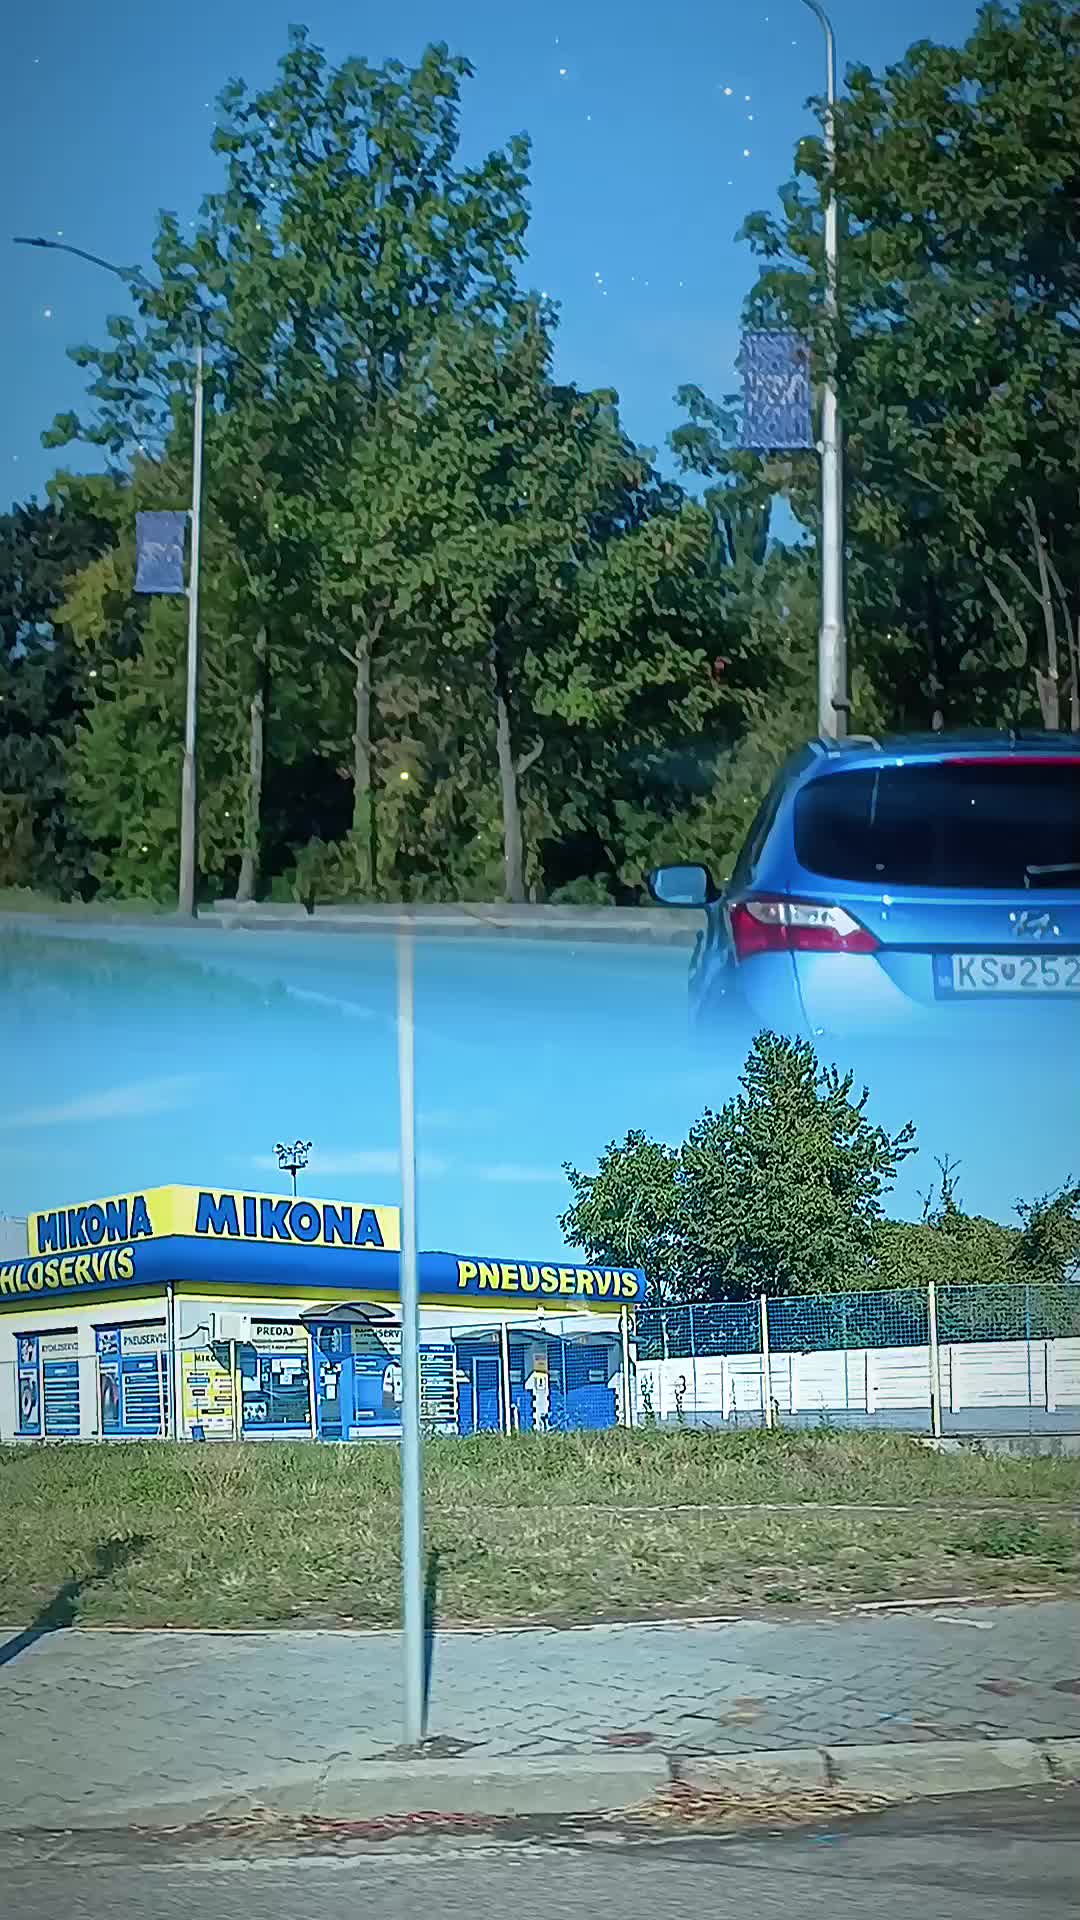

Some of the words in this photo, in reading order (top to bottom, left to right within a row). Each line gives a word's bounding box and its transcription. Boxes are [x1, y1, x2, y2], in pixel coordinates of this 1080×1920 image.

[959, 957, 998, 987] KS
[1020, 957, 1080, 987] 252
[37, 1195, 152, 1253] MIKONA
[195, 1192, 384, 1247] MIKONA
[0, 1247, 134, 1295] HLOSERVIS
[457, 1260, 639, 1297] PNEUSERVIS
[256, 1326, 294, 1337] PREDAJ
